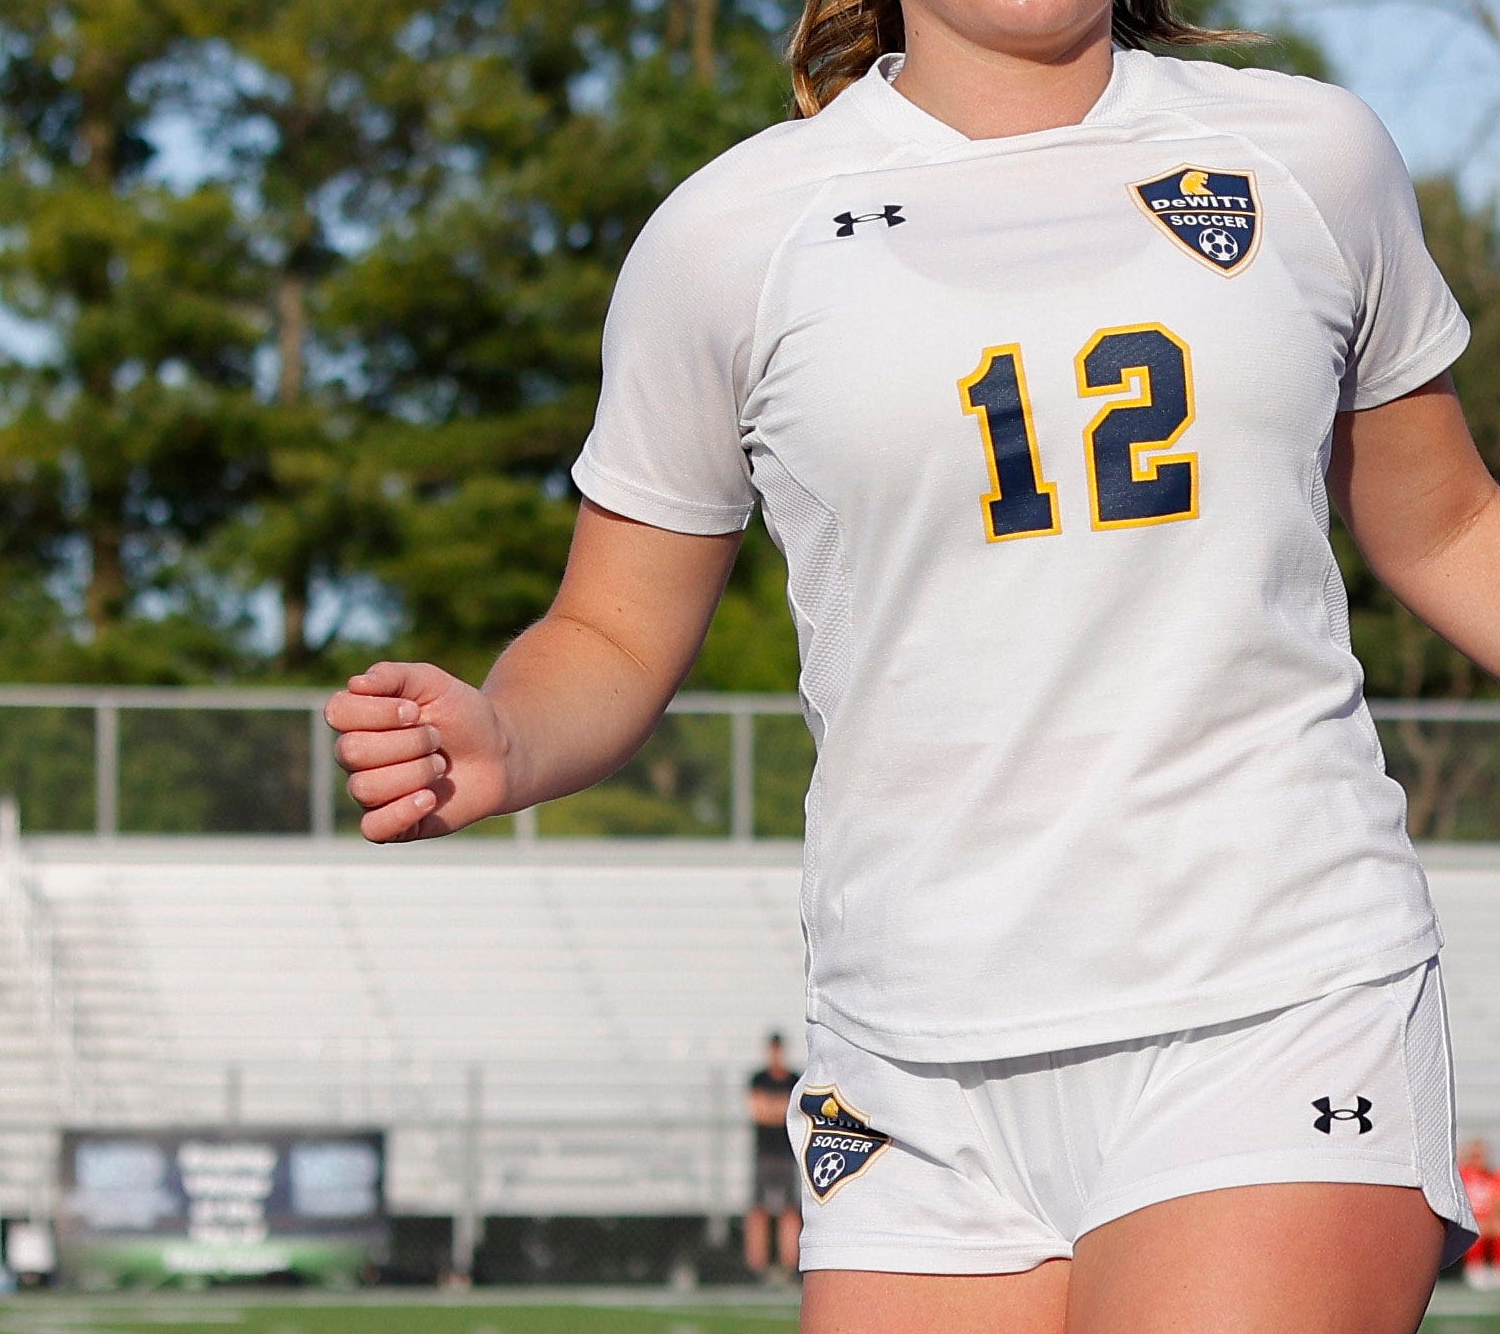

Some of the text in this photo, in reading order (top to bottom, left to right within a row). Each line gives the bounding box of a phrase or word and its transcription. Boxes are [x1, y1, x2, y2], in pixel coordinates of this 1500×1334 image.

[1151, 195, 1249, 210] DeWITT
[1170, 214, 1249, 229] SOCCER
[957, 322, 1201, 544] 12
[812, 1135, 874, 1153] SOCCER
